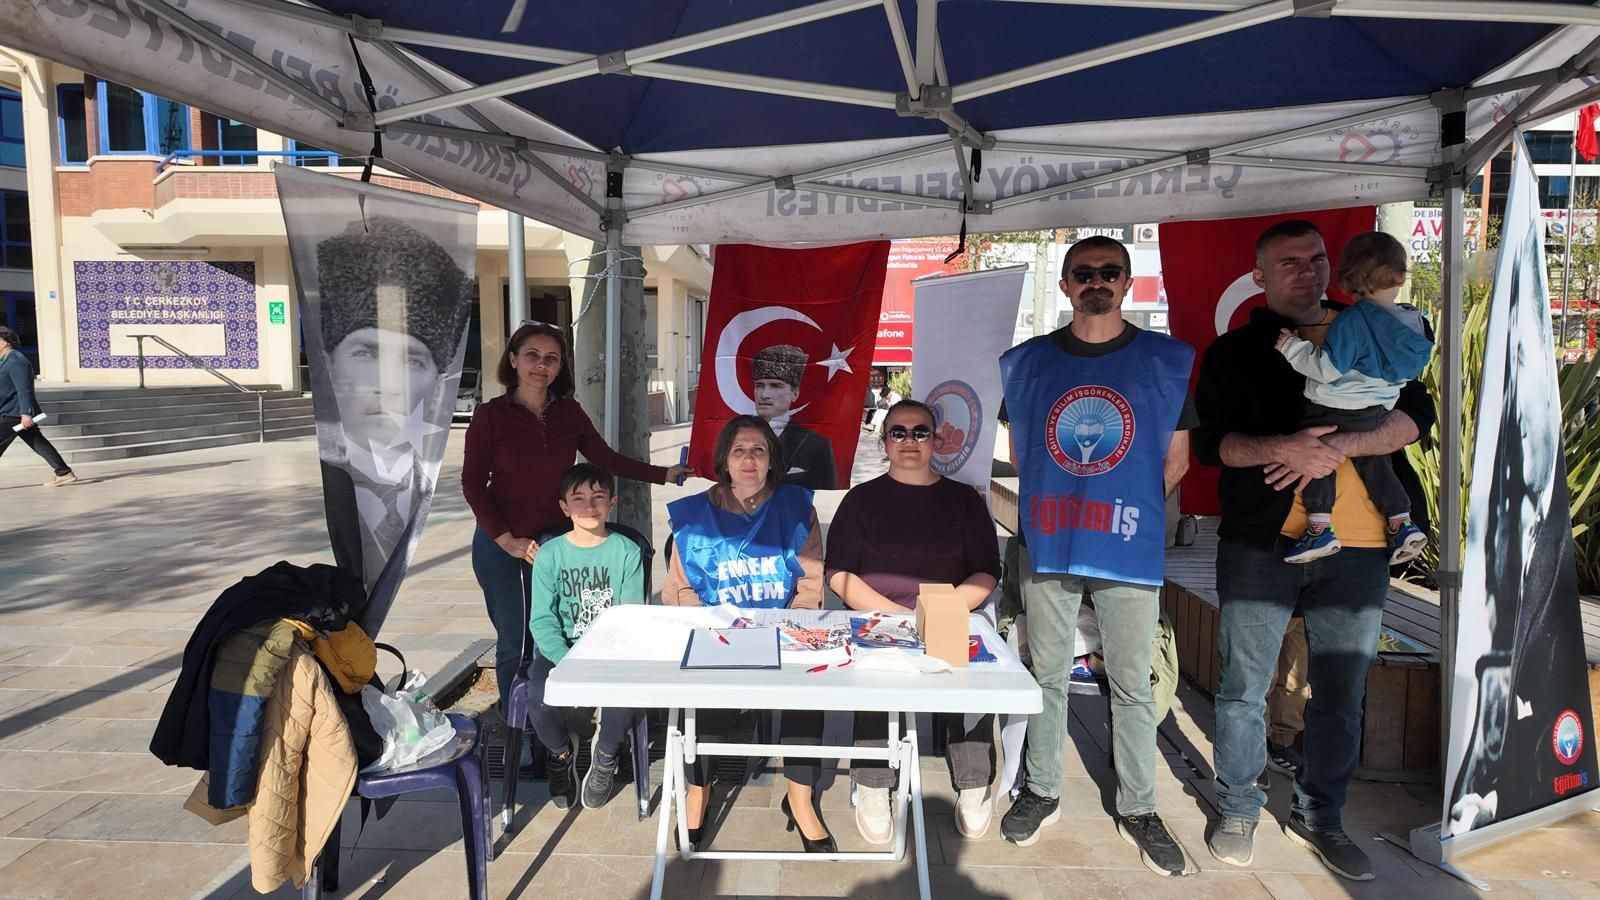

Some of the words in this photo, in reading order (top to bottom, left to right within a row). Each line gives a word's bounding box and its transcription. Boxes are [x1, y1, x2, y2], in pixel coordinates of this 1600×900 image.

[1055, 394, 1074, 414] BİLİM
[1074, 388, 1128, 414] İŞGÖRENLERİ
[718, 556, 778, 582] EMEK
[561, 566, 611, 603] BREAK
